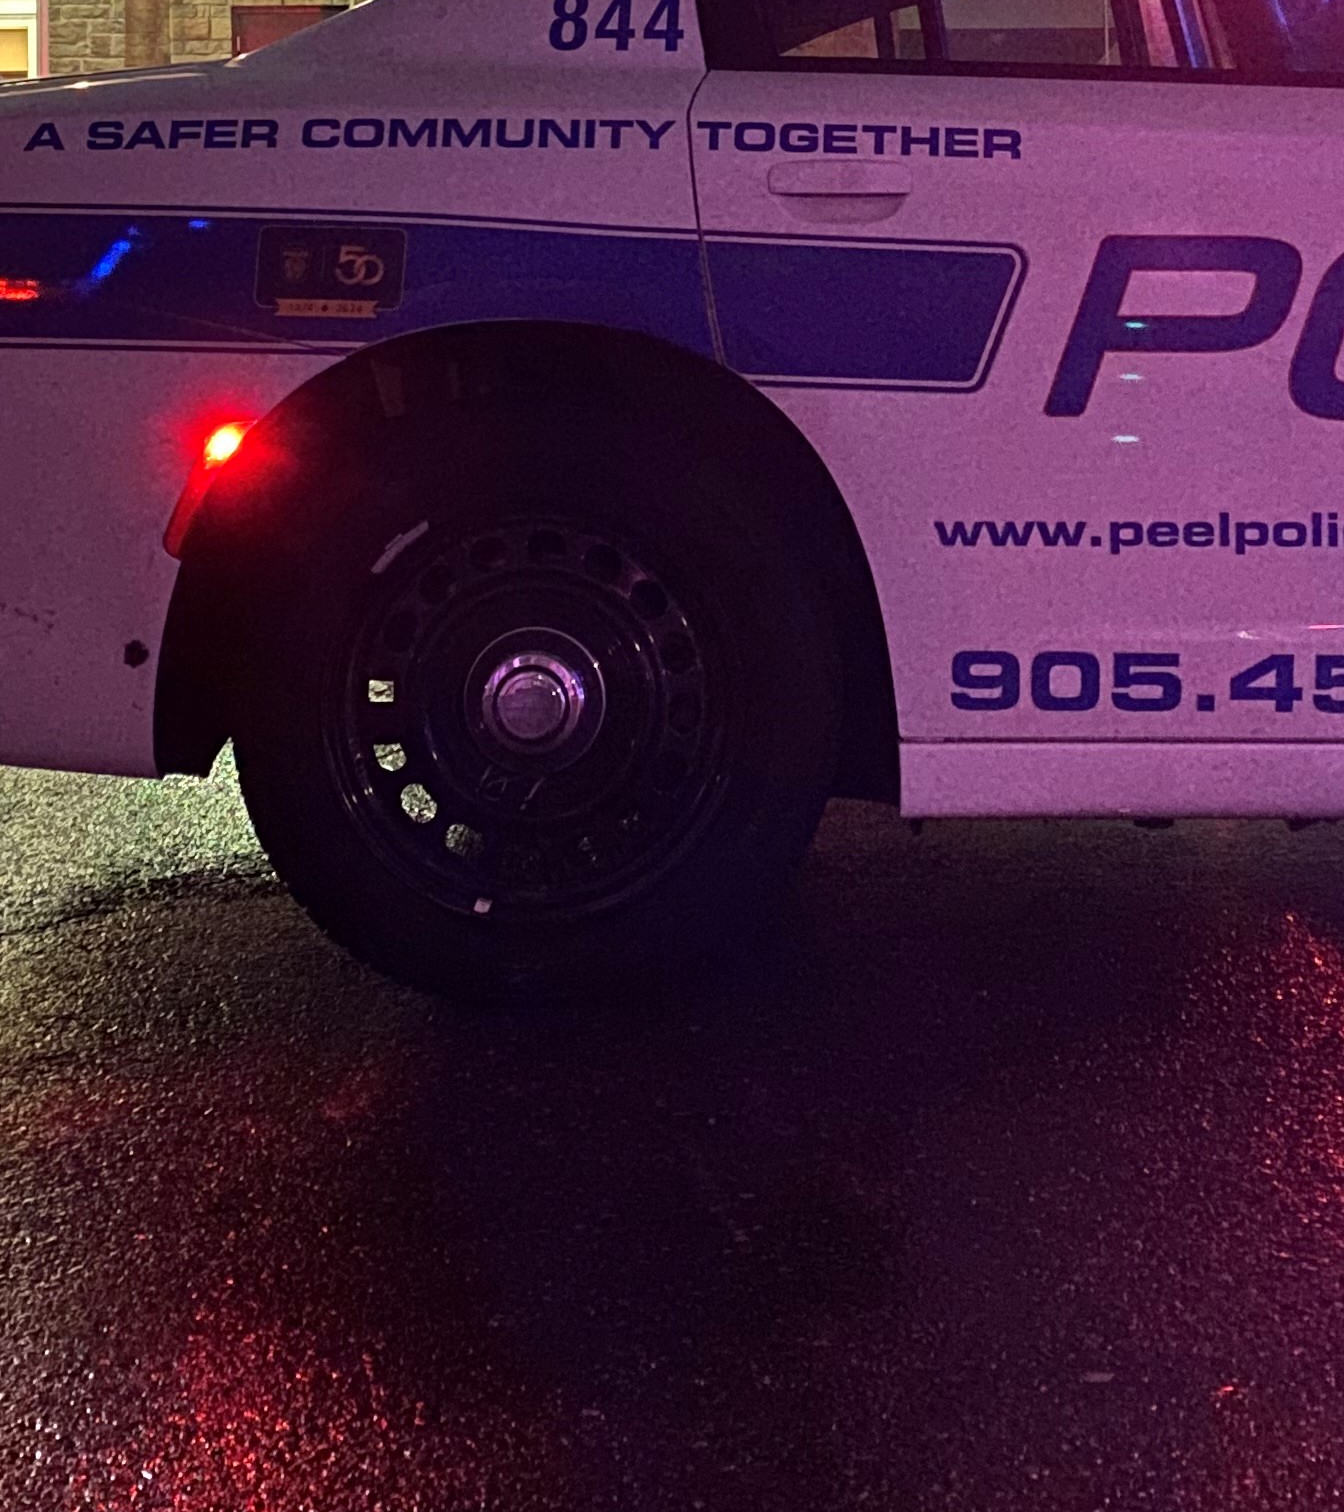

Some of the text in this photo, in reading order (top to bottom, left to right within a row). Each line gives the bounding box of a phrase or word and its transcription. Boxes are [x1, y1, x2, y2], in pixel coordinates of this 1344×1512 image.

[23, 118, 1023, 160] A SAFER COMMUNITY TOGETHER
[335, 245, 385, 286] 50
